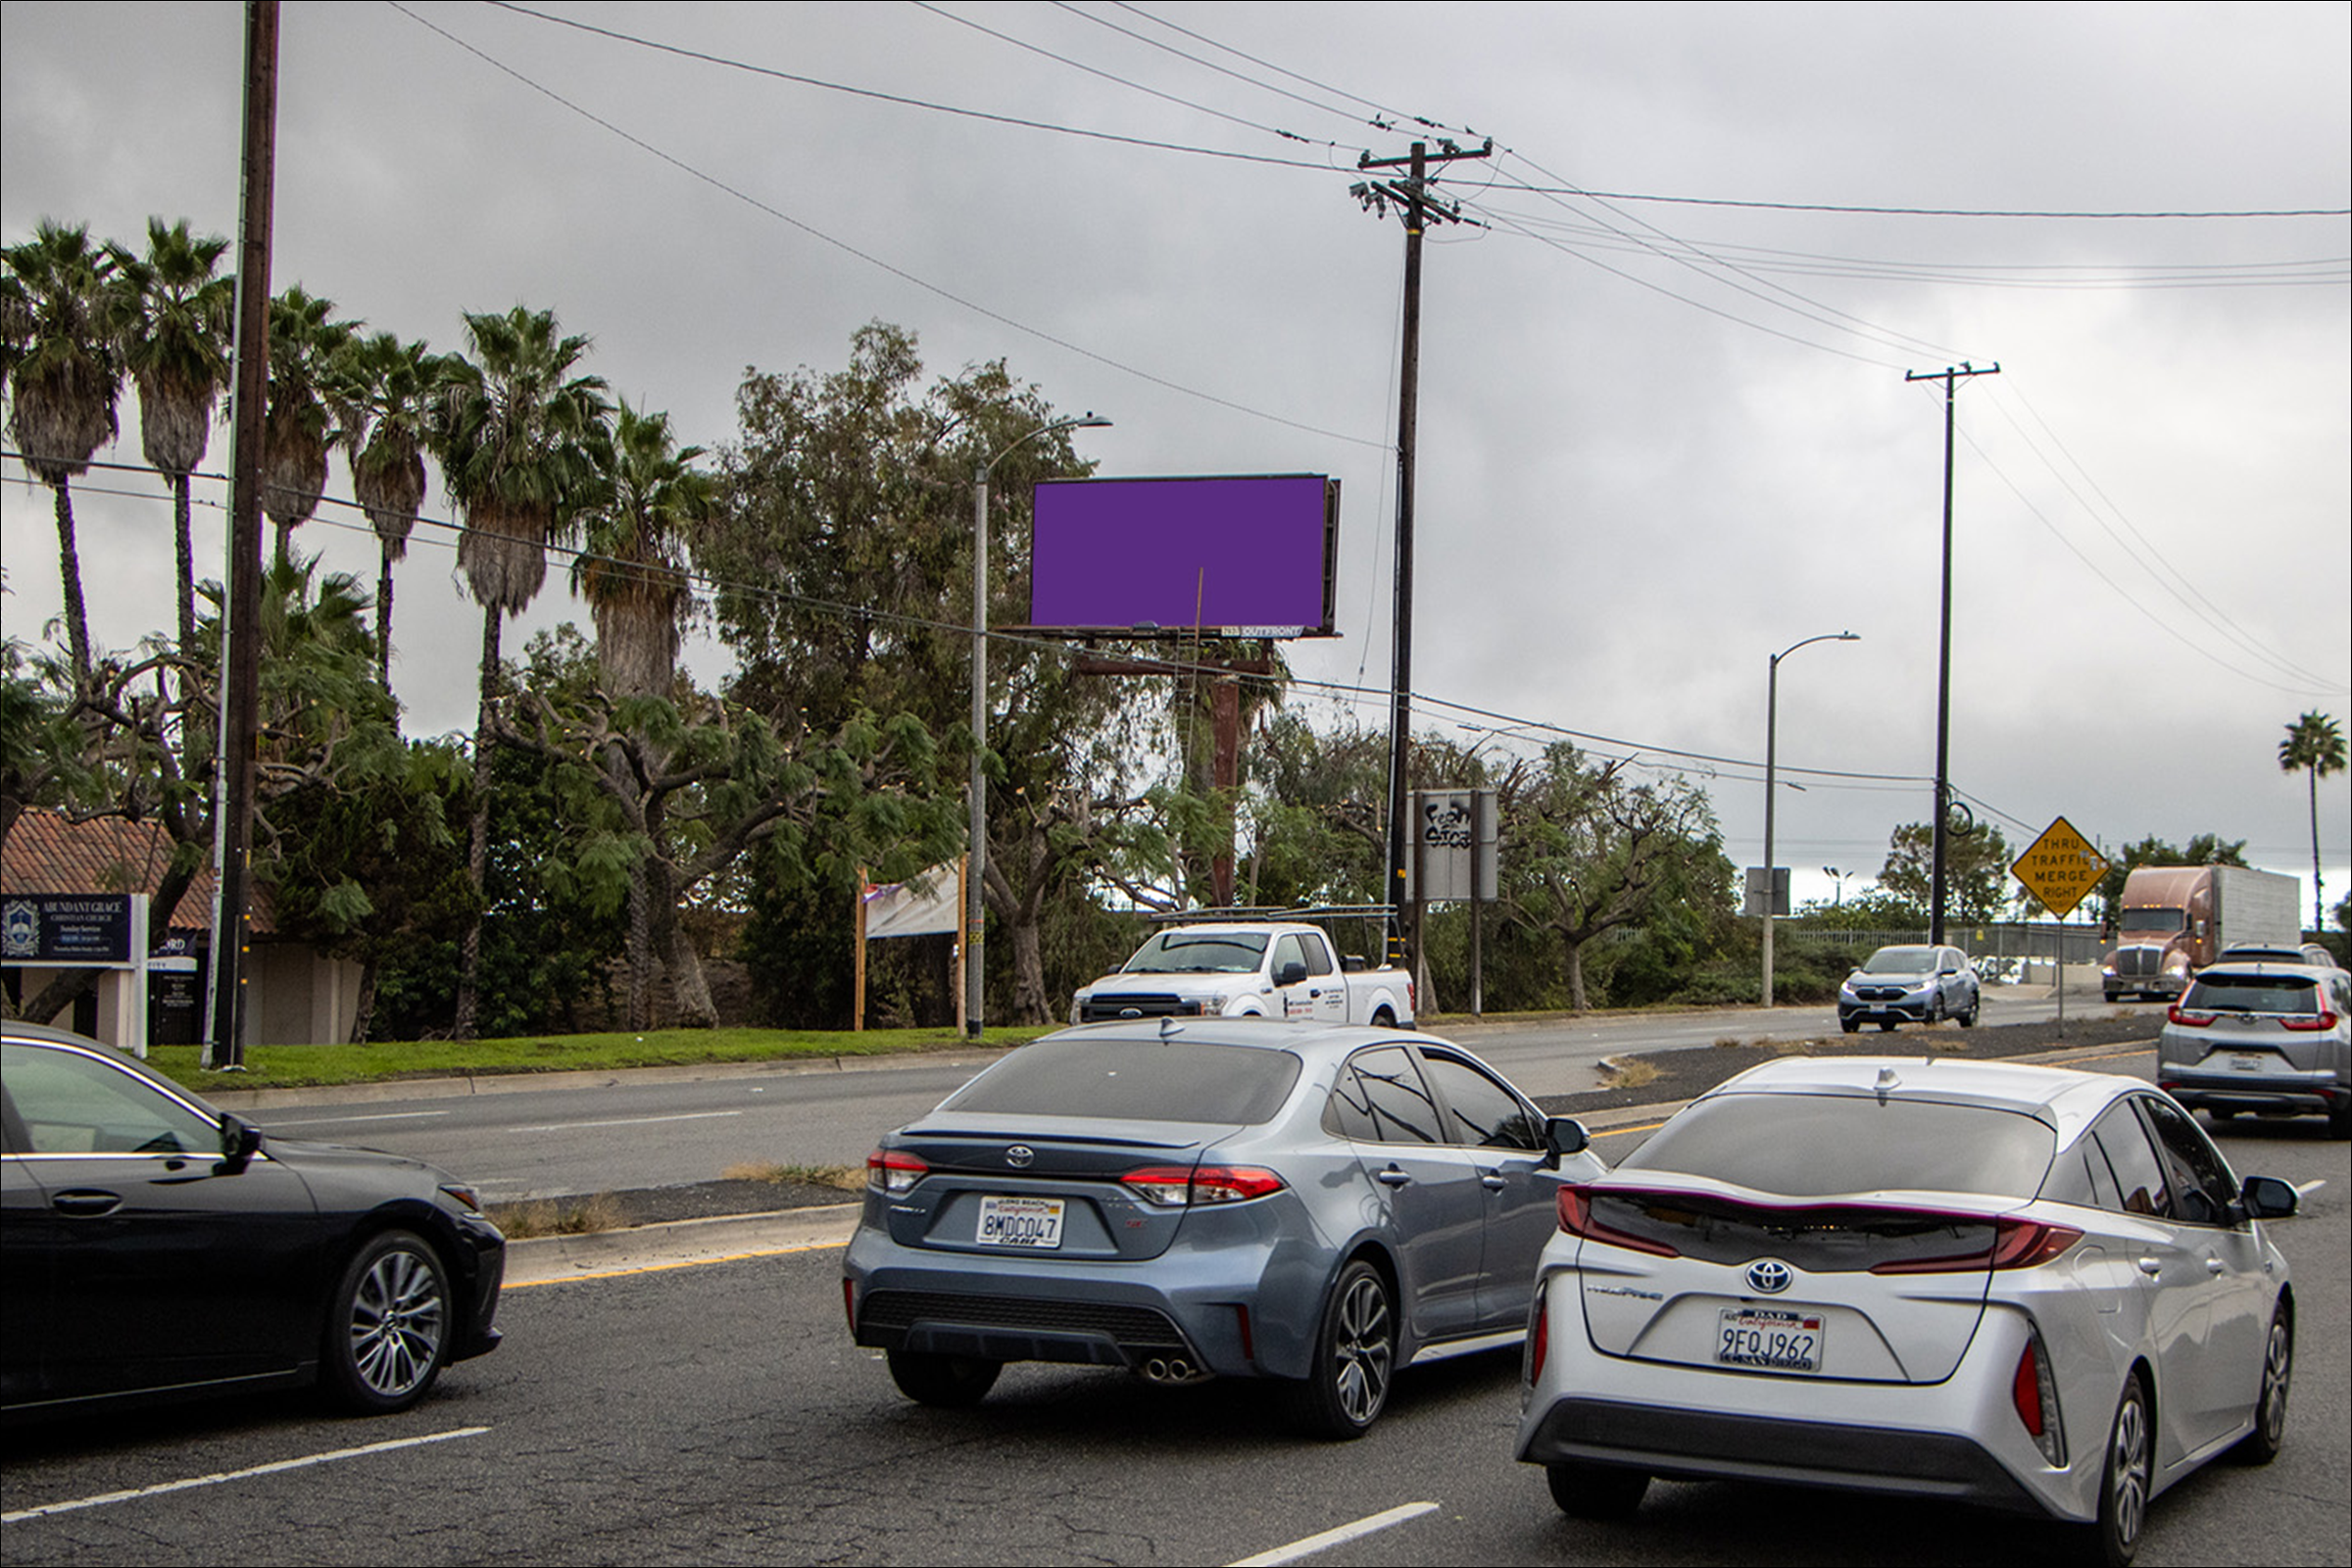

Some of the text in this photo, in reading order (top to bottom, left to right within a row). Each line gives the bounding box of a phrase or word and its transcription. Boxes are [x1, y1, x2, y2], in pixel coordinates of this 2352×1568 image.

[2043, 839, 2080, 850] THRU
[2034, 871, 2087, 882] MERGE
[2043, 887, 2078, 899] RIGHT
[984, 1214, 1056, 1239] 8MDC047
[1754, 1310, 1788, 1319] DAD
